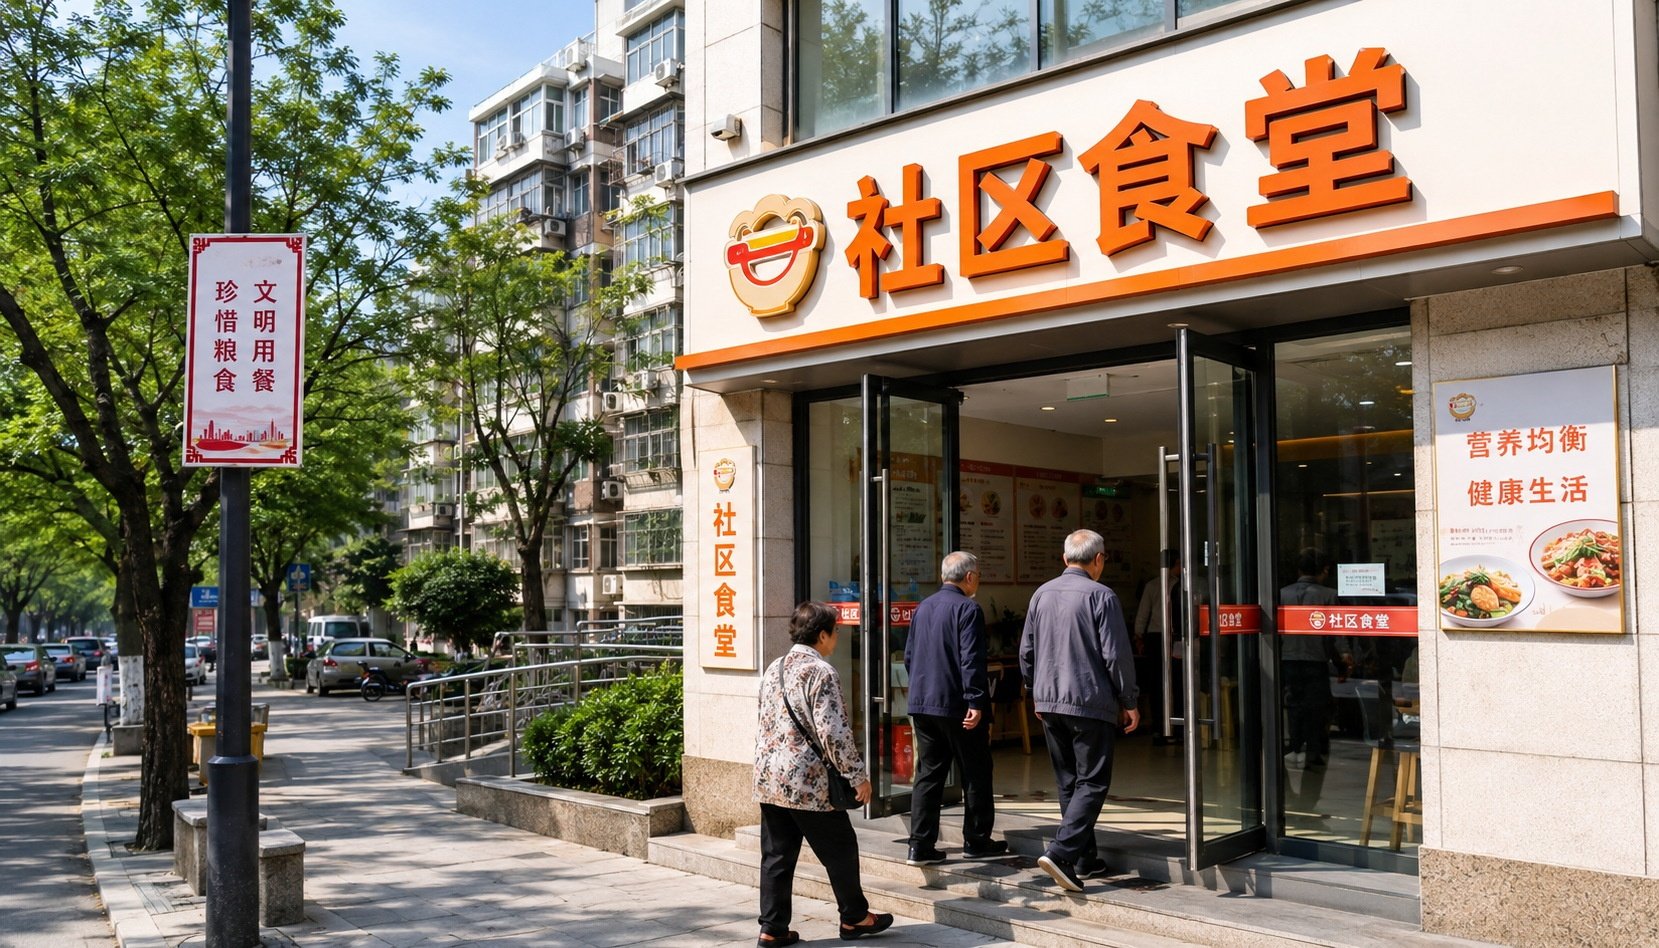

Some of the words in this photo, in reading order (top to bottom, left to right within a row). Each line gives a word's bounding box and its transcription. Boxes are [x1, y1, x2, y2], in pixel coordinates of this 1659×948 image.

[844, 46, 1414, 300] 社区食堂
[213, 280, 238, 393] 珍惜粮食
[252, 280, 277, 393] 文明用餐
[1467, 425, 1587, 460] 营养均衡
[1467, 475, 1588, 507] 健康生活
[713, 501, 737, 658] 社区食堂
[1219, 611, 1242, 627] 区食堂
[1328, 612, 1391, 630] 社区食堂
